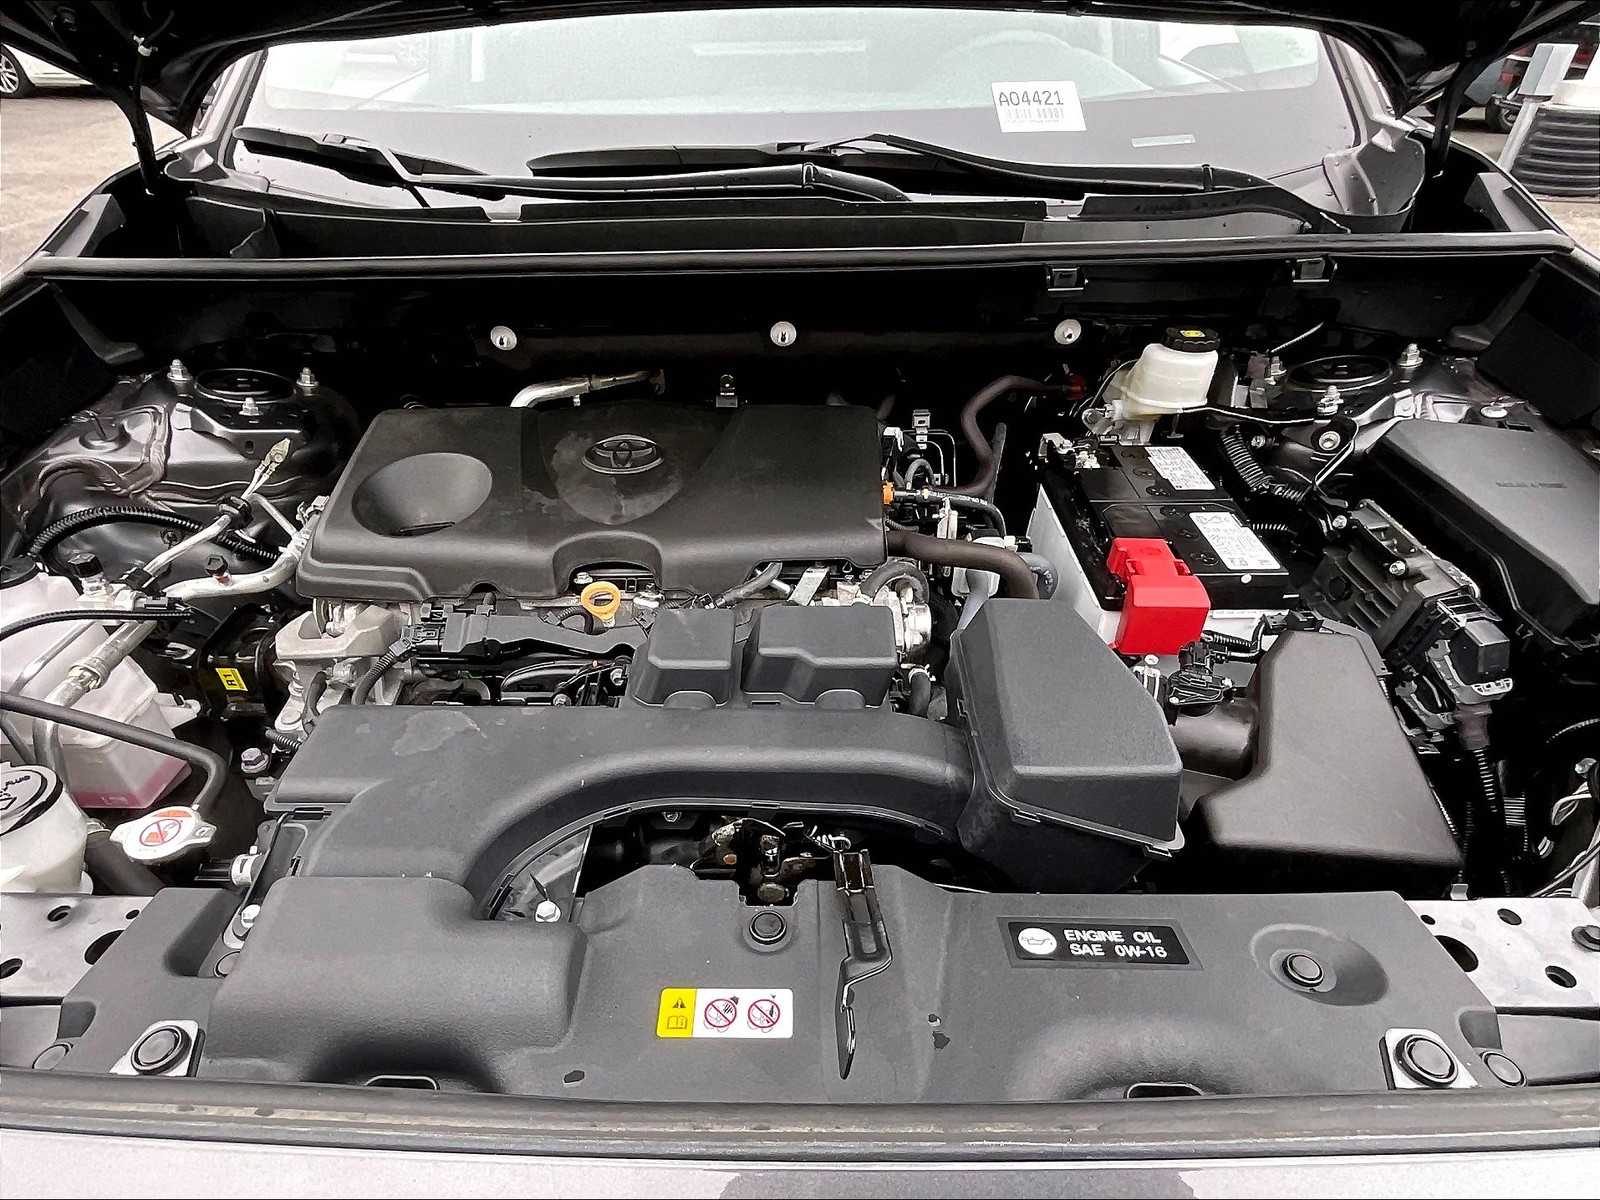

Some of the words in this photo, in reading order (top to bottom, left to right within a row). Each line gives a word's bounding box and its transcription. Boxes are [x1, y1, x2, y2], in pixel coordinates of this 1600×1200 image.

[998, 90, 1064, 106] A04421
[1064, 929, 1124, 943] ENGINE
[1132, 931, 1162, 944] OIL
[1070, 944, 1105, 956] SAE
[1115, 945, 1168, 958] 0W-16
